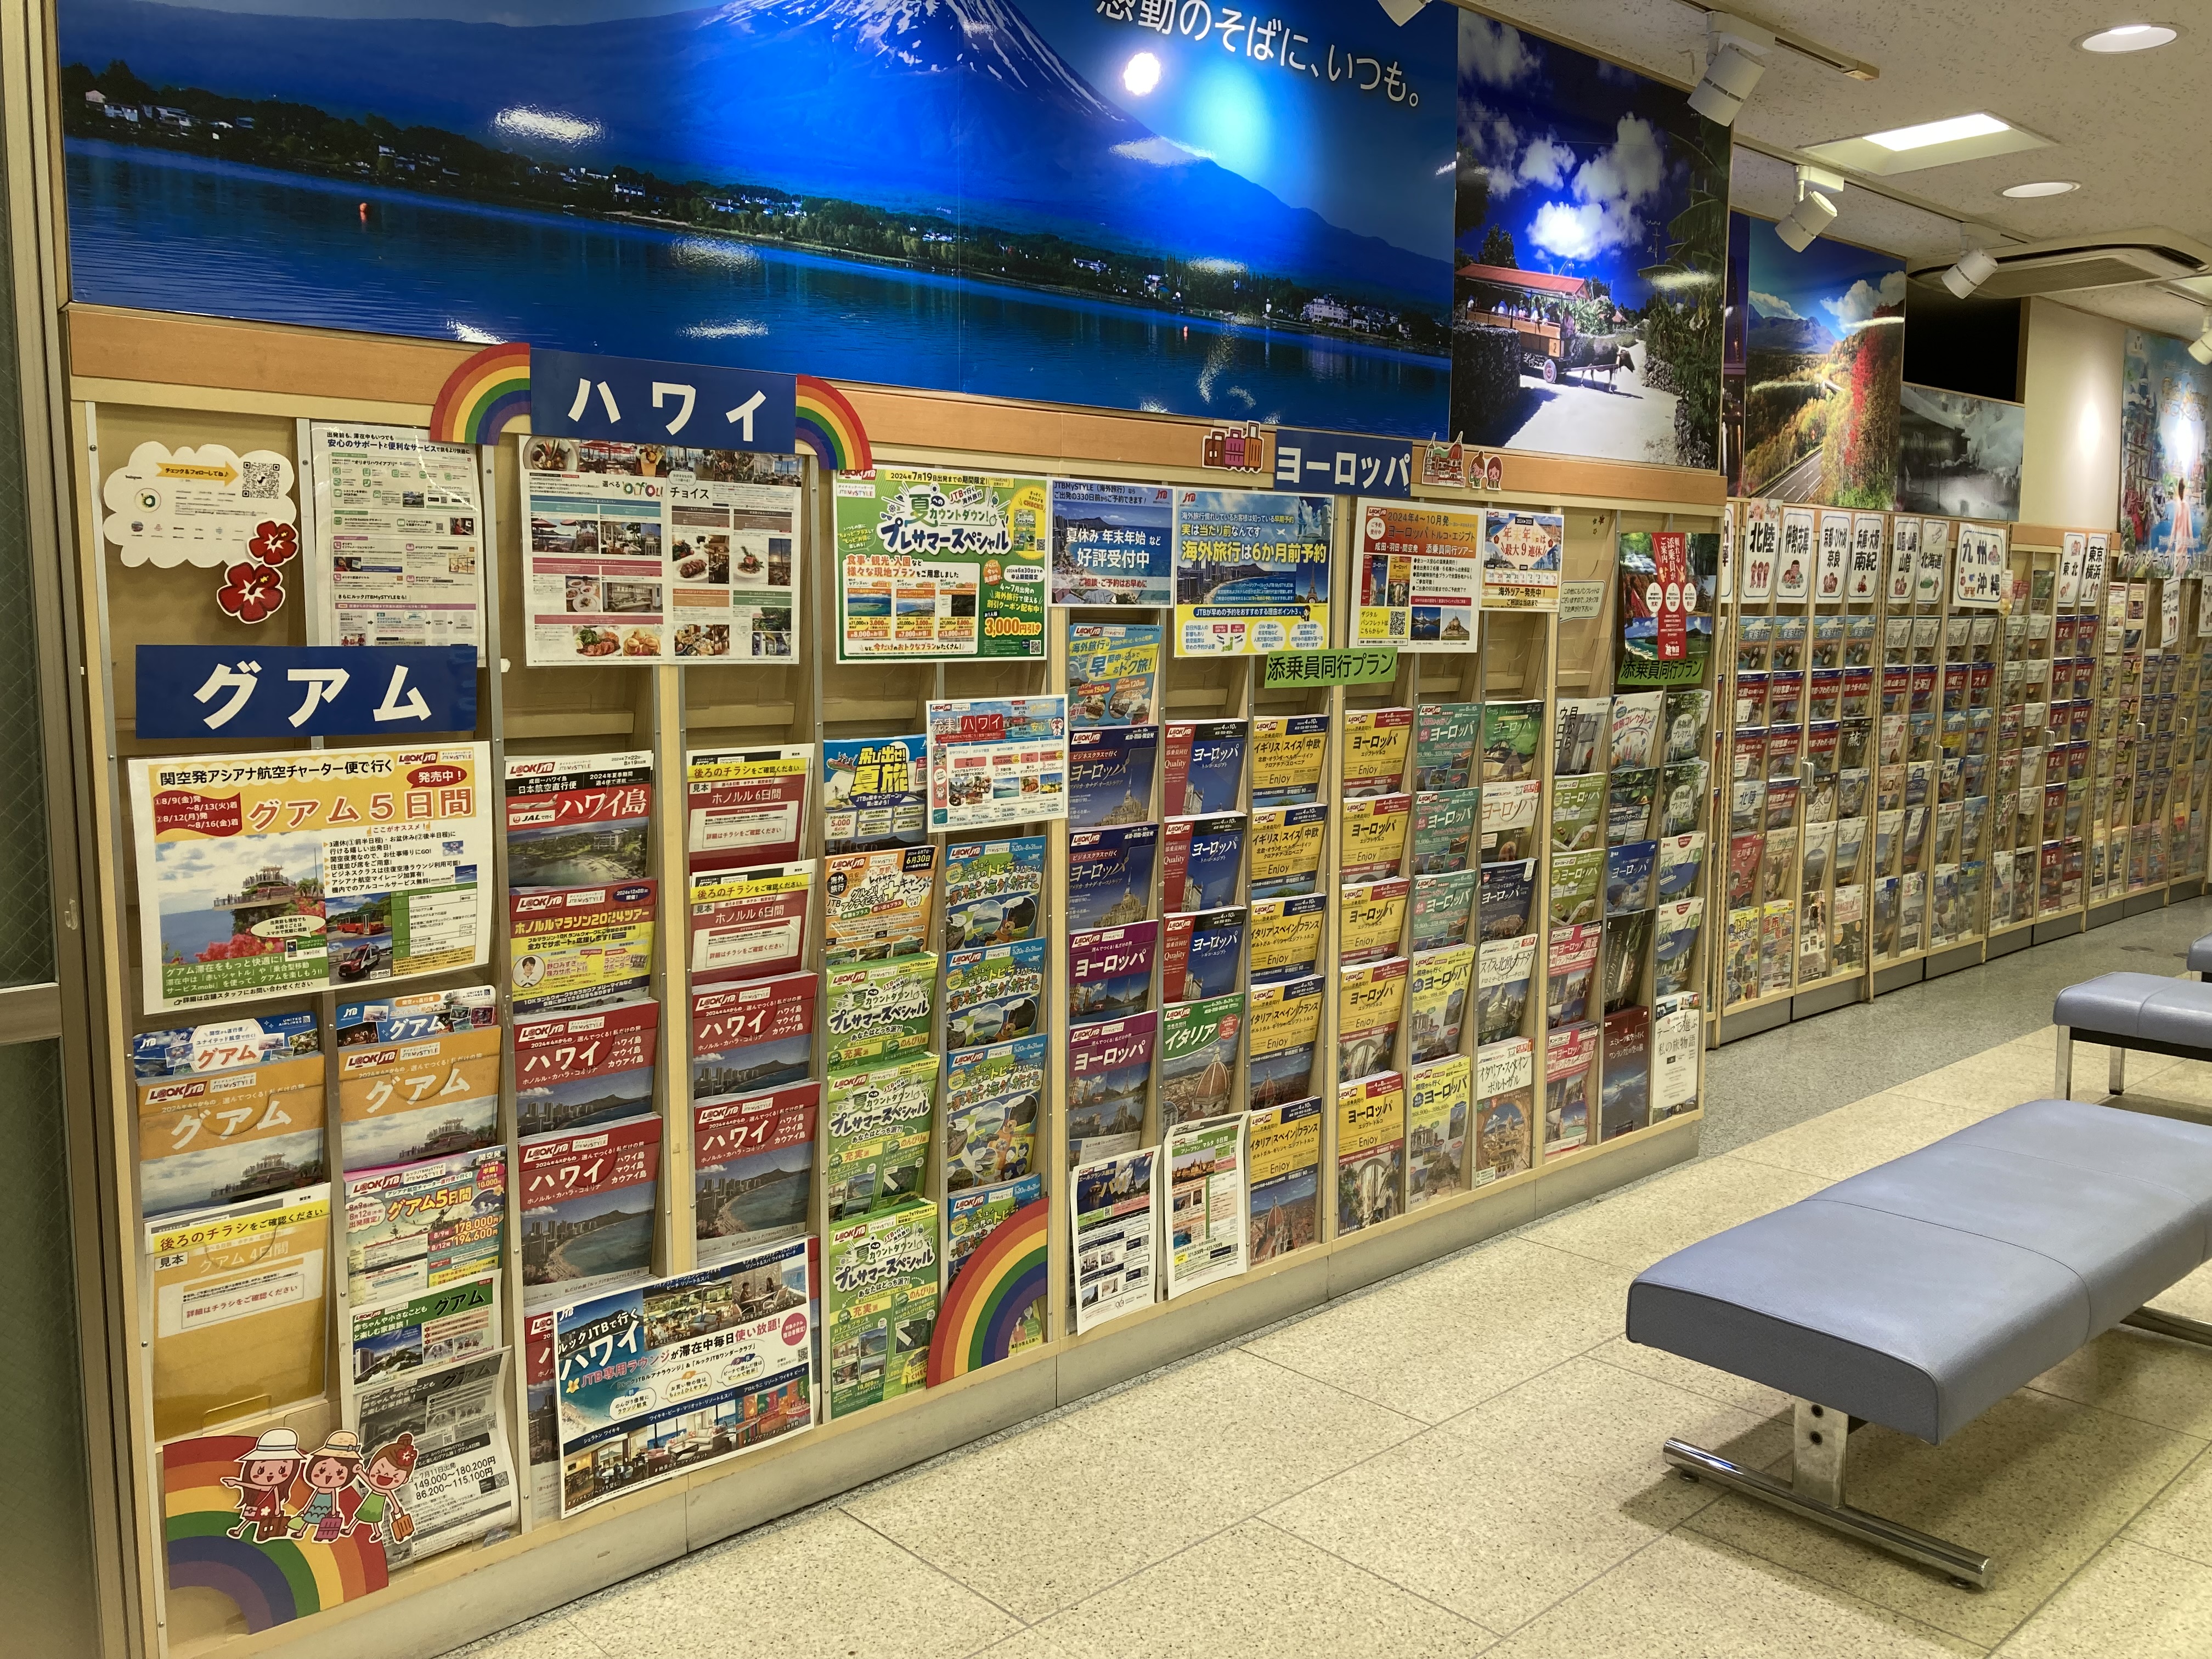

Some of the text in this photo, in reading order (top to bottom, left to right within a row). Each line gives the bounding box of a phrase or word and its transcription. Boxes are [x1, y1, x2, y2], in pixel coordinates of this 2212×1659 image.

[568, 377, 766, 442] ハワイ
[1277, 447, 1410, 489] ヨーロッパ
[670, 487, 709, 499] チョイス
[962, 490, 983, 505] 海外旅行
[1155, 489, 1168, 499] JTB
[1182, 492, 1197, 502] JTB
[1181, 511, 1294, 523] 海外旅行慣れしているお客様は知っている早期予約
[881, 517, 1009, 551] プレサマースペシャル
[1066, 527, 1161, 546] 夏休み 年末年始 など
[1181, 524, 1261, 538] 実は当たり前なんです
[1387, 525, 1429, 539] ヨーロッパ
[1502, 526, 1546, 544] 年末年始は
[1750, 522, 1775, 553] 北陸
[1077, 548, 1150, 568] 好評受付中
[1181, 541, 1327, 563] 海外旅行は6か月前予約
[1426, 544, 1474, 555] 添乗員同行ツアー
[1667, 538, 1676, 580] 添乗員が
[1962, 538, 1988, 565] 九州
[2088, 546, 2104, 563] 東京
[846, 554, 922, 567] 食事・観光・入園など
[1854, 551, 1877, 571] 南紀
[1921, 552, 1943, 569] 北海道
[2063, 562, 2079, 576] 東北
[847, 566, 959, 578] 様々な現地プランをご用意しました
[2085, 564, 2101, 580] 横浜
[1079, 578, 1147, 589] ご相談・ご予約はお早めに
[1498, 586, 1547, 597] 海外ツアー発売中！
[994, 592, 1038, 604] 海外旅行で使える
[985, 617, 1042, 635] 3,000円引き
[1268, 653, 1394, 682] 添乗員同行プラン
[1620, 659, 1702, 680] 添乗員同行プラン
[193, 660, 432, 730] グアム
[963, 715, 1001, 730] ハワイ
[1430, 720, 1475, 742] ヨーロッパ
[1254, 738, 1321, 753] イギリス スイス 中欧
[1353, 732, 1398, 749] ヨーロッパ
[399, 754, 423, 764] LOOK
[1073, 750, 1118, 760] ビジネスクラスで行く
[1193, 743, 1240, 763] ヨーロッパ
[160, 759, 393, 786] 関空発アシアナ航空チャーター便で行く
[693, 765, 800, 779] 後ろのチラシをご確認ください
[1164, 760, 1186, 770] Quality
[1358, 764, 1378, 775] Enjoy
[418, 770, 462, 783] 発売中！
[851, 763, 909, 797] 夏旅
[1269, 774, 1291, 786] Enjoy
[518, 781, 577, 794] 日本航空直行便
[712, 788, 782, 805] ホノルル 6日間
[1562, 788, 1601, 804] ヨーロッパ
[556, 788, 647, 819] ハワイ島
[522, 814, 553, 822] JALで行く
[706, 827, 782, 840] 詳細はチラシをご確認ください
[1352, 819, 1397, 837] ヨーロッパ
[1192, 837, 1239, 857] ヨーロッパ
[1357, 850, 1377, 862] Enjoy
[1164, 855, 1186, 865] Quality
[1268, 864, 1290, 875] Enjoy
[1611, 858, 1652, 879] ヨーロッパ
[697, 881, 803, 901] 後ろのチラシをご確認ください
[515, 908, 650, 935] ホノルルマラソン2024ツアー
[1274, 920, 1319, 935] スペイン フランス
[1075, 948, 1147, 978] ヨーロッパ
[1267, 953, 1289, 966] Enjoy
[1481, 951, 1533, 975] スイス・北欧・カナダ
[183, 981, 313, 1003] 詳細は店舗スタッフにお問い合わせください
[699, 1009, 766, 1039] ハワイ
[830, 1000, 928, 1031] プレサマースペシャル
[389, 1013, 444, 1042] グアム
[1165, 1023, 1217, 1051] イタリア
[524, 1035, 641, 1073] ハワイ ハワイ島
[612, 1046, 641, 1057] マウイ島
[1658, 1035, 1696, 1054] 私の旅物語
[198, 1045, 258, 1070] グアム
[607, 1054, 644, 1068] カウアイ島
[1074, 1040, 1147, 1071] ヨーロッパ
[1480, 1057, 1529, 1081] イタリア・スペイン
[366, 1068, 471, 1114] グアム
[1424, 1075, 1468, 1104] ヨーロッパ
[1487, 1074, 1521, 1094] ポルトガル
[1348, 1099, 1393, 1124] ヨーロッパ
[171, 1099, 292, 1150] グアム
[703, 1120, 769, 1151] ハワイ
[1358, 1135, 1378, 1147] Enjoy
[478, 1150, 501, 1162] 関空発
[529, 1158, 605, 1192] ハワイ
[1270, 1160, 1290, 1175] Enjoy
[387, 1186, 472, 1221] グアム5日間
[160, 1209, 323, 1251] 後ろのチラシをご確認ください
[159, 1254, 184, 1269] 見本
[835, 1250, 934, 1290] プレサマースペシャル
[187, 1285, 298, 1318] 詳細はチラシをご確認ください
[434, 1290, 485, 1315] グアム
[354, 1306, 427, 1332] 赤ちゃんや小さなこども
[558, 1310, 638, 1355] ルックJTBで行く
[561, 1321, 640, 1381] ハワイ
[580, 1317, 781, 1389] JTB専用ラウンジが滞在中毎日使い放題!
[583, 1426, 620, 1443] シェラトン ワイキキ
